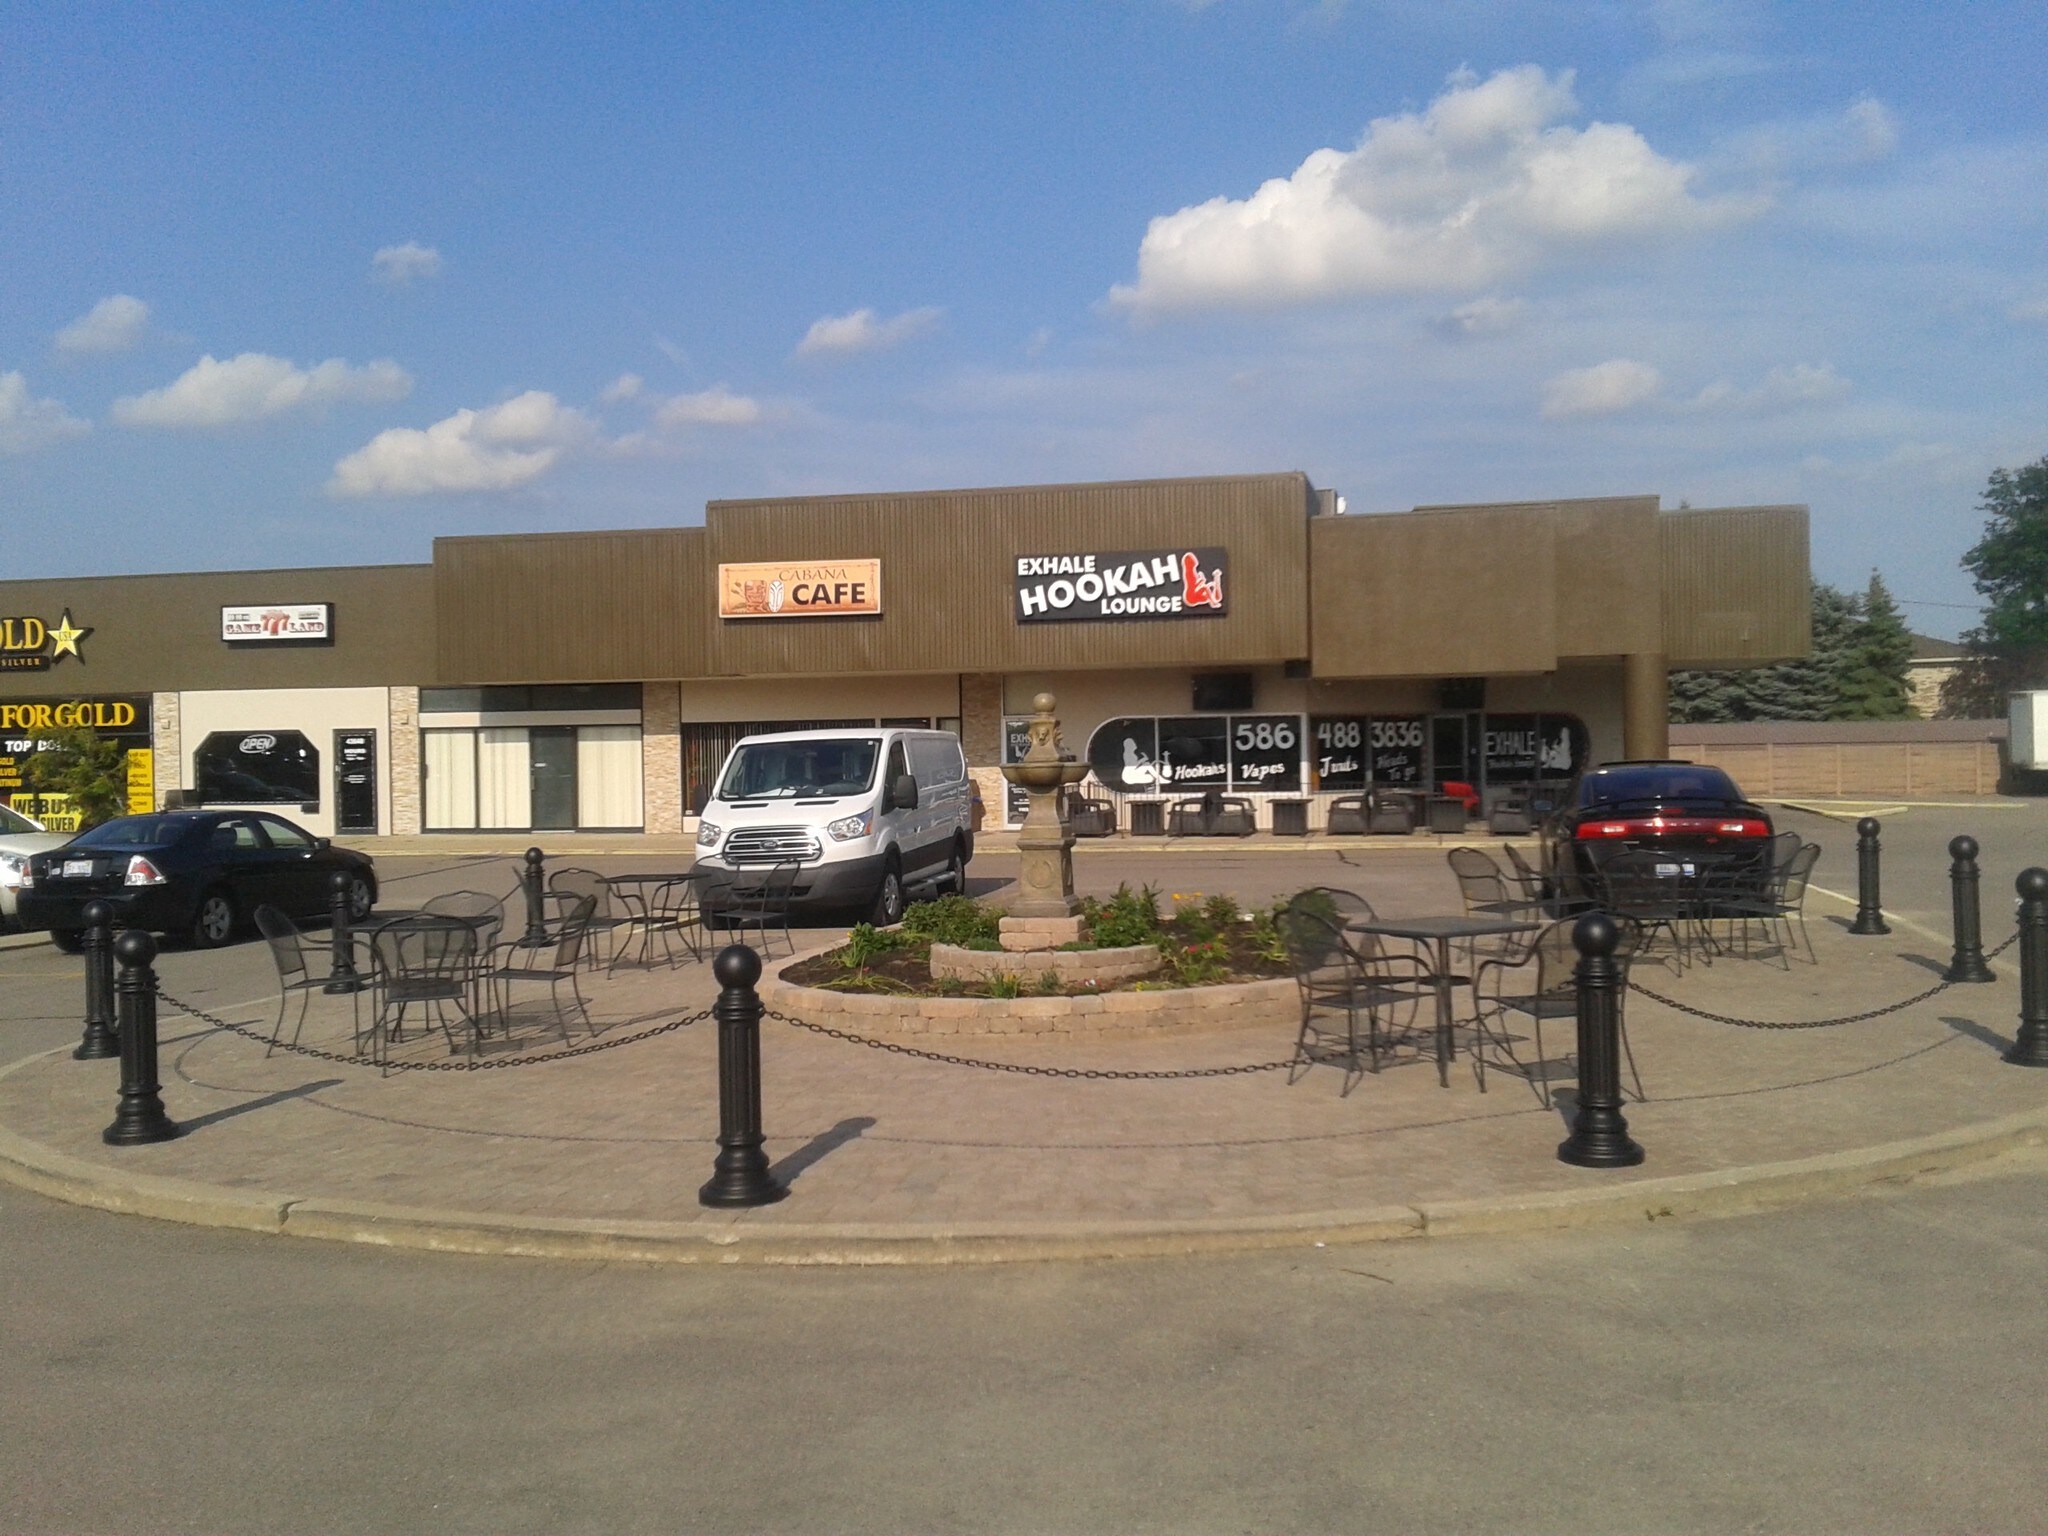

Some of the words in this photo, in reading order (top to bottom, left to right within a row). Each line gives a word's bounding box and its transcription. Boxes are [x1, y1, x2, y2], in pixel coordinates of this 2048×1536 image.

[778, 568, 847, 582] CABANA
[1018, 556, 1095, 576] EXHALE
[792, 583, 865, 605] CAFE
[1019, 554, 1181, 616] HOOKAH
[1101, 596, 1183, 615] LOUNGE
[0, 618, 45, 650] LD
[289, 621, 325, 633] LAND
[1, 658, 40, 666] SILVER
[0, 704, 54, 729] FOR
[54, 702, 135, 727] GOLD
[241, 737, 273, 751] OPEN
[1235, 722, 1295, 751] 586
[1318, 721, 1360, 749] 488
[1371, 721, 1423, 748] 3836
[5, 740, 32, 752] TOP
[1241, 763, 1285, 780] Vapes
[41, 816, 75, 832] SILVER
